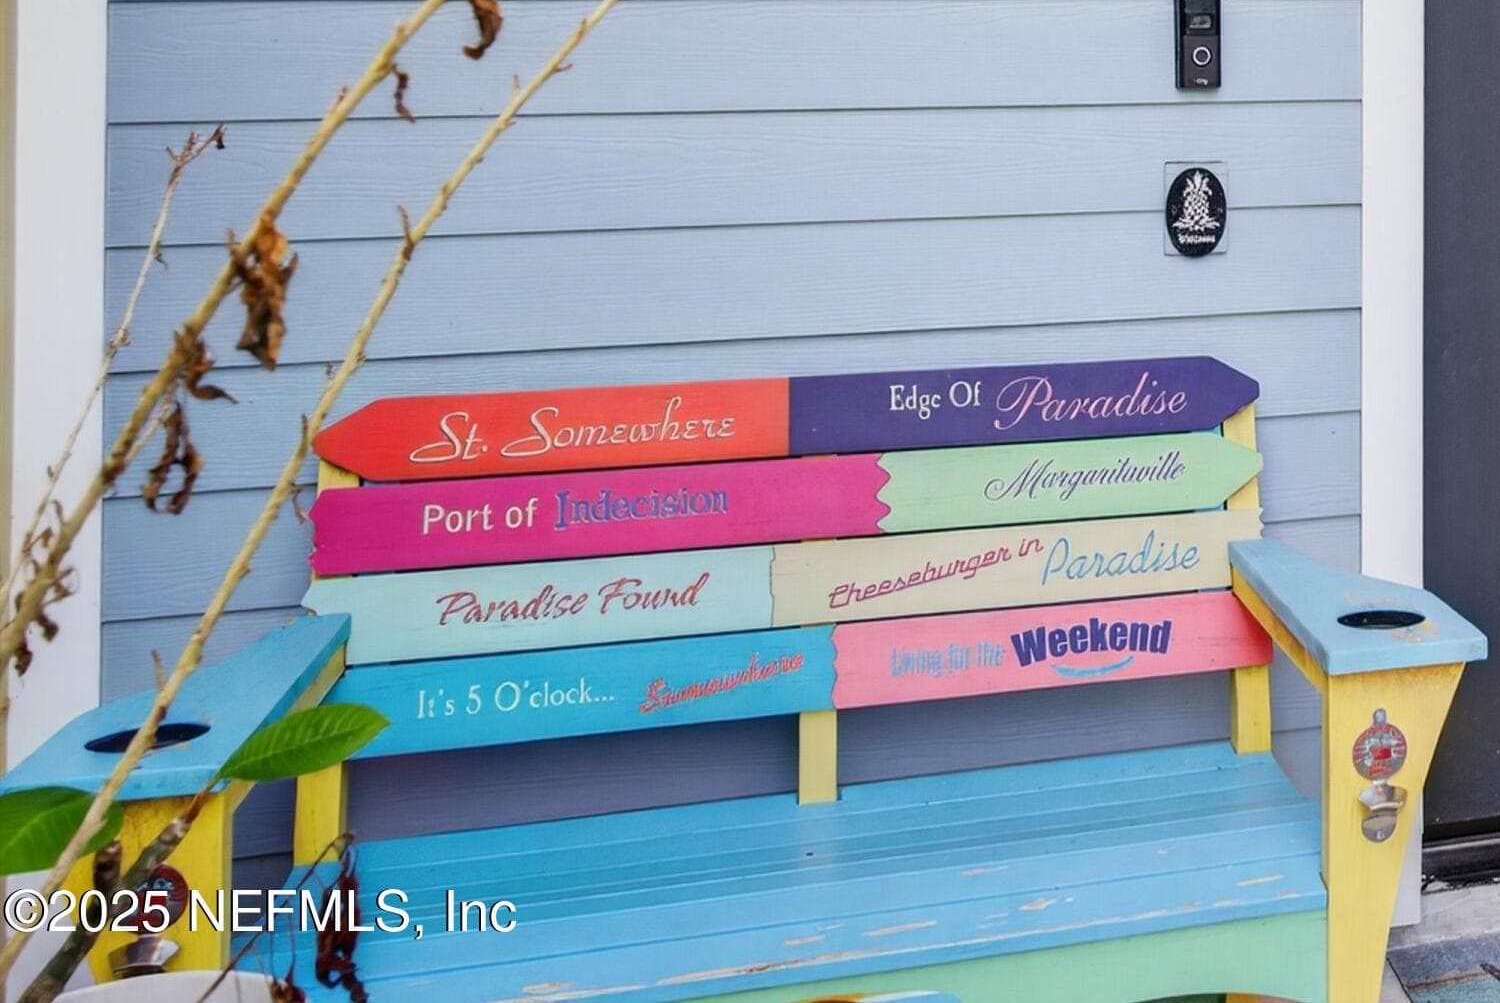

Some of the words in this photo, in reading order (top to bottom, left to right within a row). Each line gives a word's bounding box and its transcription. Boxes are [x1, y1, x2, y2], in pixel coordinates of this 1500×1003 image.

[889, 384, 942, 420] Edge
[948, 381, 982, 408] Of
[994, 372, 1188, 430] Paradise
[409, 412, 490, 463] St.
[501, 396, 736, 457] Somewhere
[984, 451, 1186, 501] Margaritaville
[422, 502, 493, 535] Port
[505, 498, 539, 528] of
[554, 489, 730, 530] Indecision
[829, 546, 1012, 609] Cheeseburger
[1018, 538, 1044, 557] in
[1041, 530, 1200, 586] Paradise
[436, 586, 588, 625] Paradise
[598, 572, 710, 613] Found
[1010, 617, 1172, 667] Weekend
[417, 689, 455, 719] It's
[466, 686, 481, 713] 5
